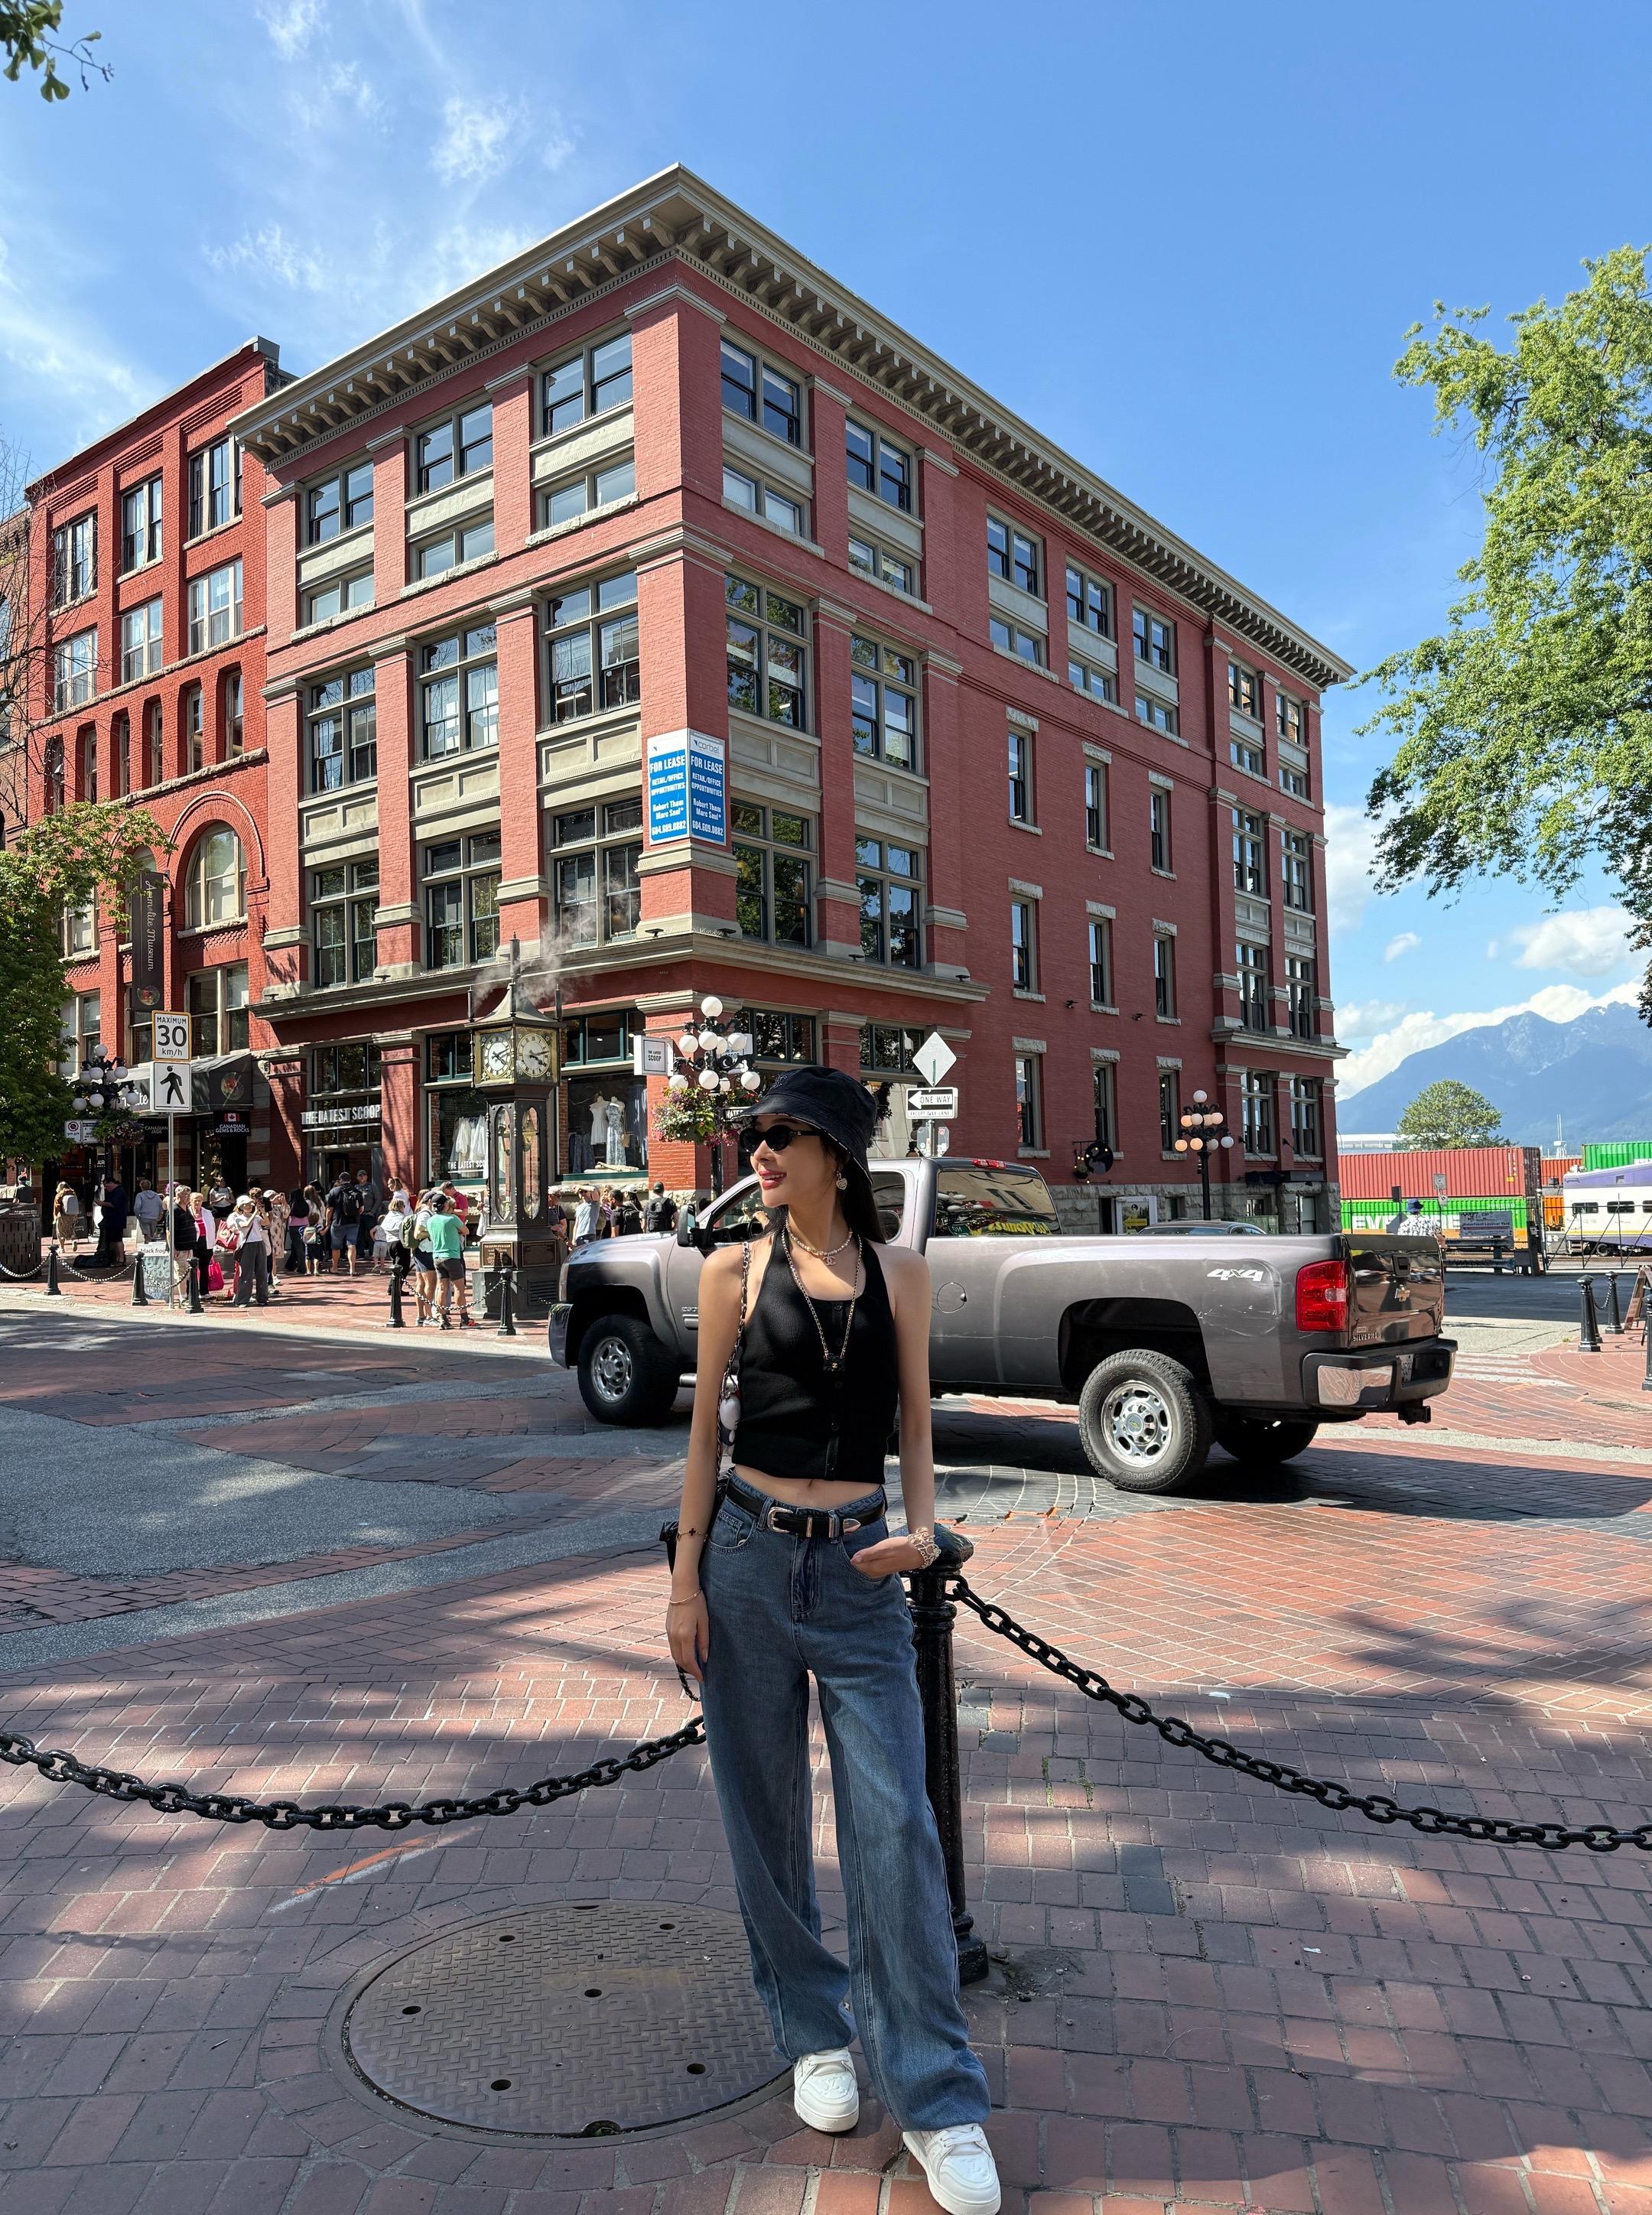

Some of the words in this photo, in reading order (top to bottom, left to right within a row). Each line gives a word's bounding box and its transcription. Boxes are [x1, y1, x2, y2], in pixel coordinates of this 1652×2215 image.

[649, 760, 662, 773] FOR
[664, 754, 685, 770] LEASE
[691, 755, 702, 769] FOR
[704, 759, 723, 775] LEASE
[652, 772, 684, 786] RETAIL/OFFICE
[691, 772, 721, 787] RETAIL/OFFICE
[651, 782, 686, 795] OPPORTUNITIES
[691, 782, 722, 797] OPPORTUNITIES
[652, 802, 669, 812] Robert
[693, 798, 708, 808] Robert
[655, 811, 669, 820] Marc
[696, 807, 707, 817] Marc
[147, 929, 156, 971] Museum
[157, 1016, 187, 1024] MAXIMUM
[158, 1025, 187, 1047] 30
[162, 1048, 183, 1056] km/h
[301, 1111, 318, 1125] THE
[318, 1108, 352, 1124] LATEST
[352, 1104, 381, 1120] SCOOP
[458, 1160, 475, 1169] LATEST
